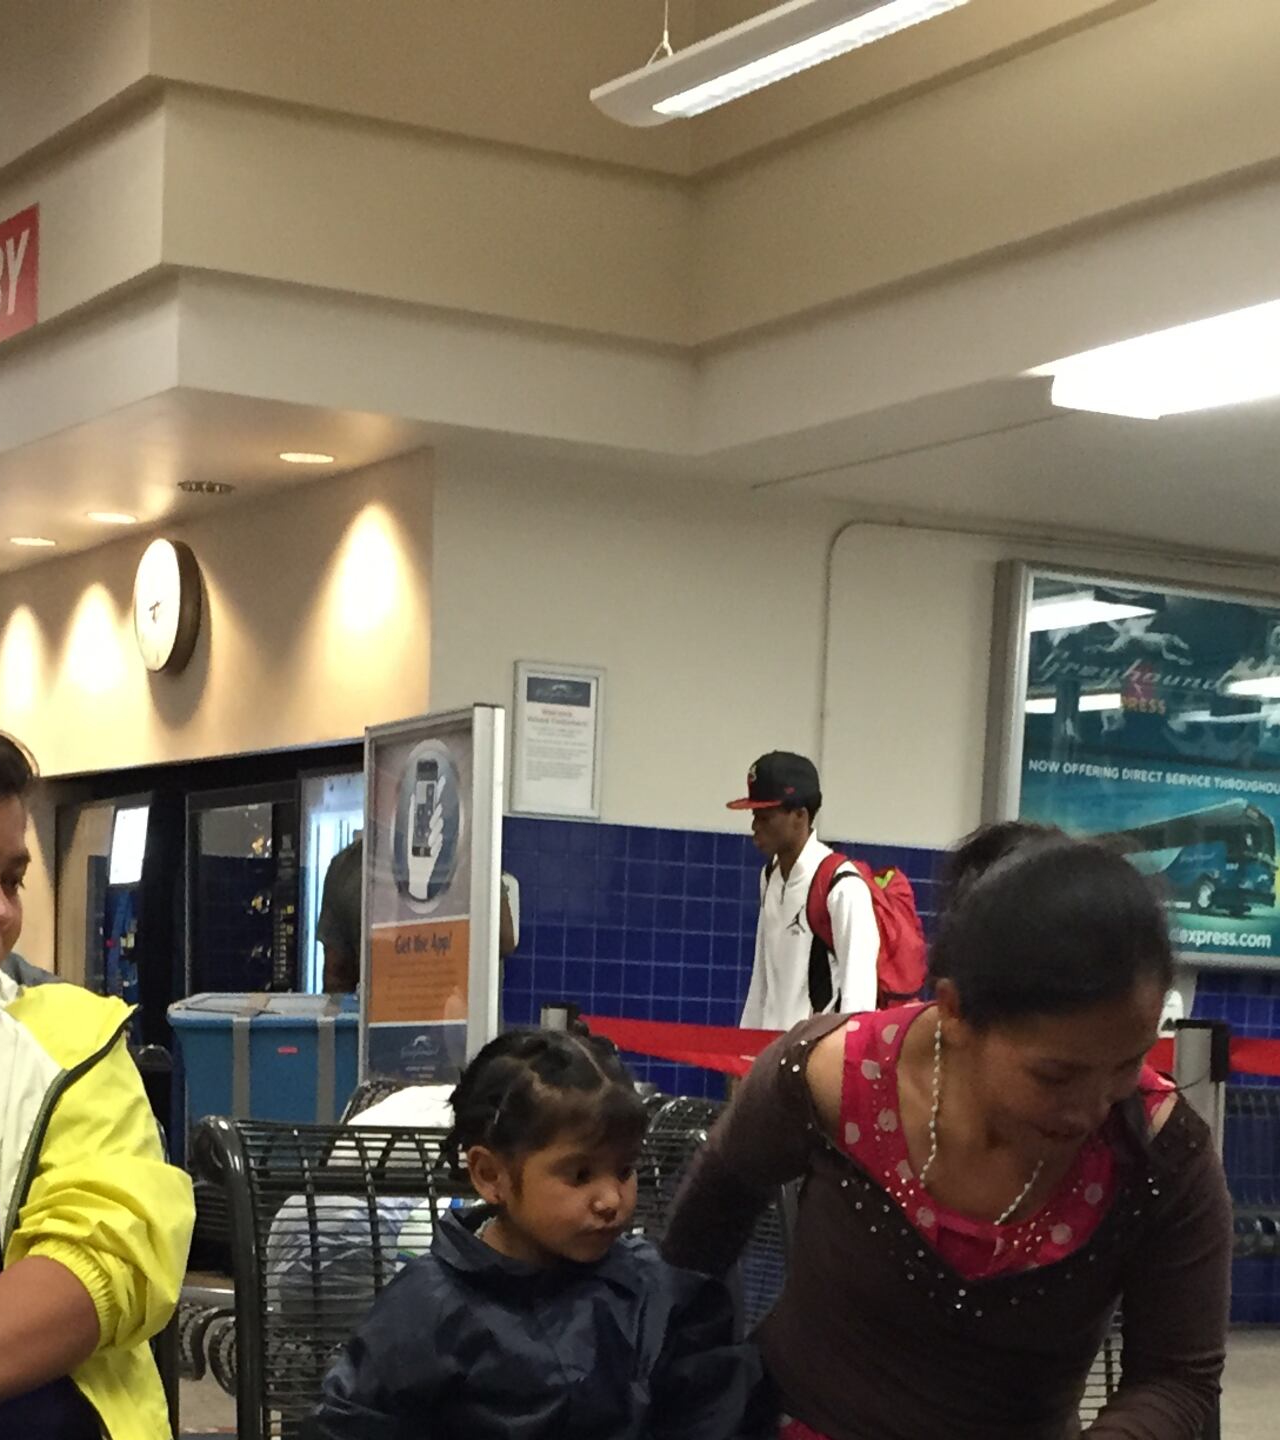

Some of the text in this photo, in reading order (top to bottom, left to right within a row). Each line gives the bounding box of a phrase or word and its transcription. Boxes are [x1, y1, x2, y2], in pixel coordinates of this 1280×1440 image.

[1029, 760, 1060, 773] NOW
[1063, 762, 1119, 780] OFFERING
[1122, 768, 1163, 783] DIRECT
[1166, 773, 1211, 788] SERVICE
